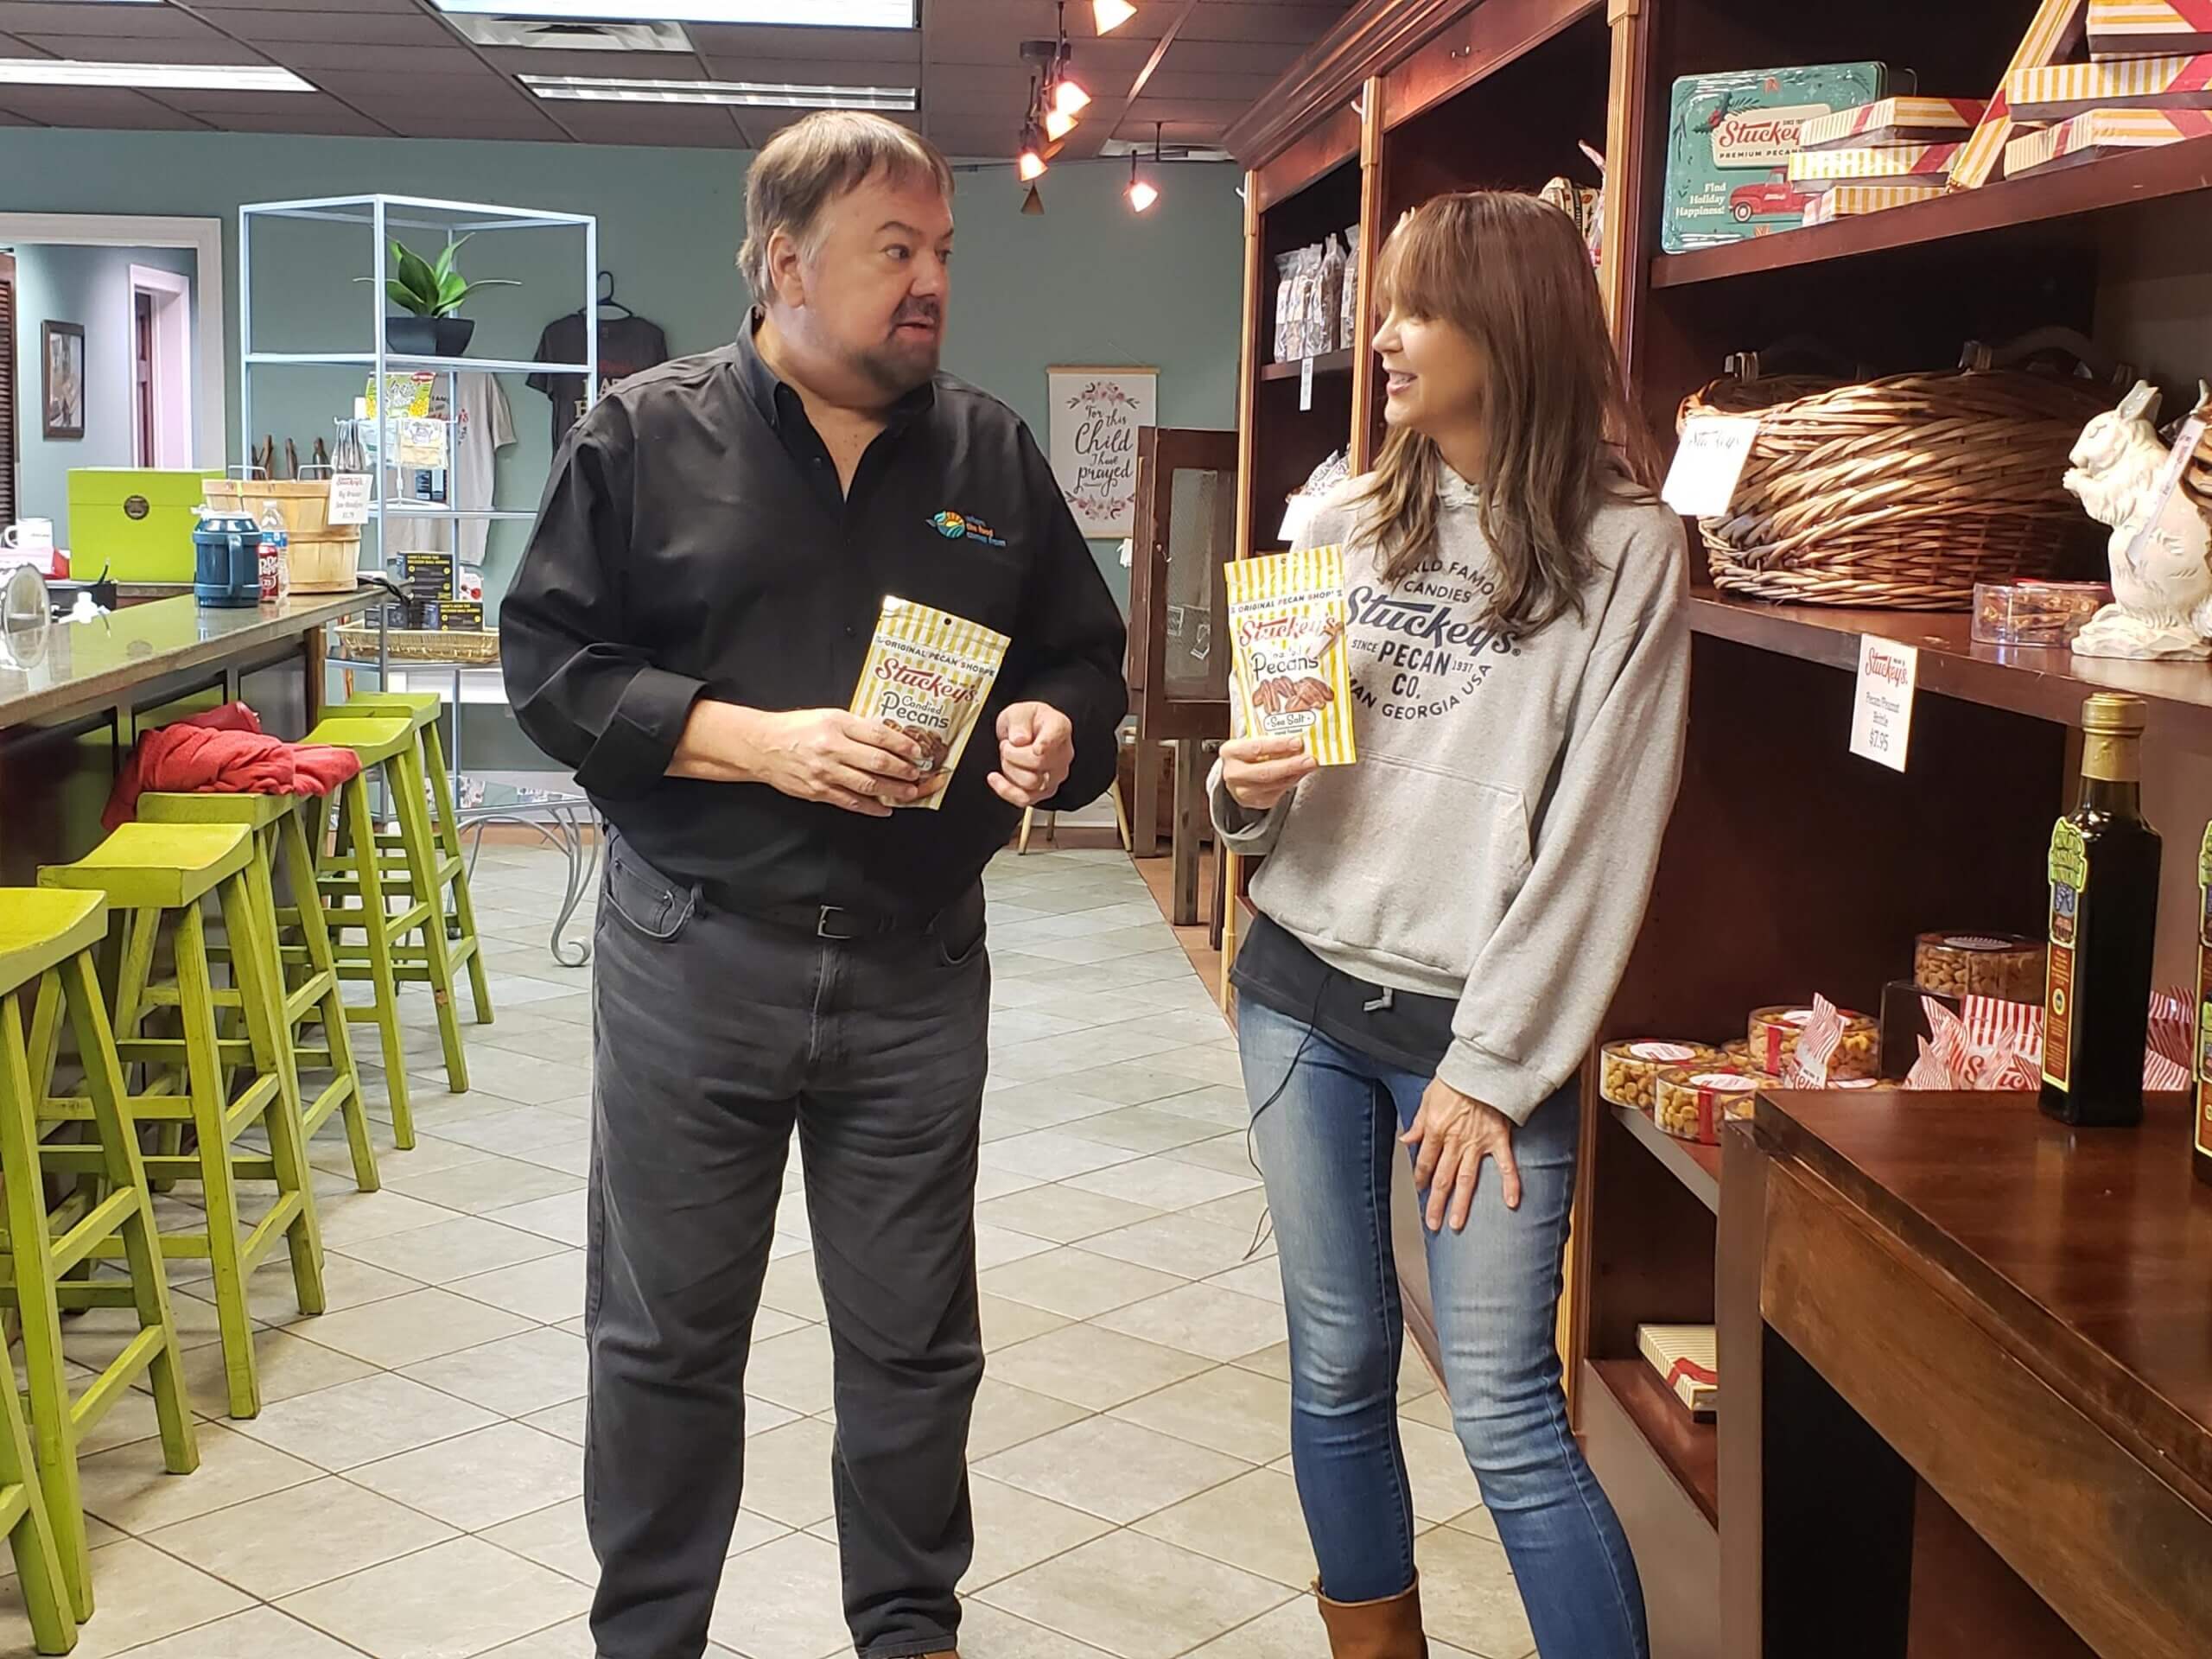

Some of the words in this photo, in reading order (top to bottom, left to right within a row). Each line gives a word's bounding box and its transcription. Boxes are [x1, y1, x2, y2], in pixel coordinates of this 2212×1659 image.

[1719, 120, 1801, 147] Stuckey
[1719, 150, 1762, 159] PREMIUM
[1690, 194, 1726, 206] Holiday
[1705, 182, 1726, 192] Find
[1675, 206, 1725, 218] Happiness!
[1085, 404, 1103, 419] For
[1106, 408, 1126, 427] this
[1075, 419, 1134, 454] Child
[1073, 458, 1134, 498] prayed
[1404, 580, 1472, 604] CANDIES
[1449, 562, 1494, 595] FAMO
[1237, 601, 1274, 613] ORIGINAL
[1279, 594, 1305, 606] PECAN
[1345, 586, 1517, 657] Stuckeys
[884, 639, 926, 658] ORIGINAL
[928, 652, 958, 666] PECAN
[960, 661, 995, 677] SHOPPE
[1251, 652, 1319, 682] Pecans
[1351, 638, 1379, 654] SINCE
[1378, 639, 1452, 677] PECAN
[1452, 660, 1474, 673] 1937
[874, 657, 976, 703] Stuckey's
[1382, 695, 1460, 721] GEORGIA
[1461, 663, 1493, 696] USA
[1391, 672, 1421, 700] CO.
[880, 690, 950, 729] Pecans
[902, 695, 944, 715] Candied
[1270, 715, 1286, 728] Sea
[1287, 714, 1306, 726] Salt
[1869, 728, 1890, 753] $7.95
